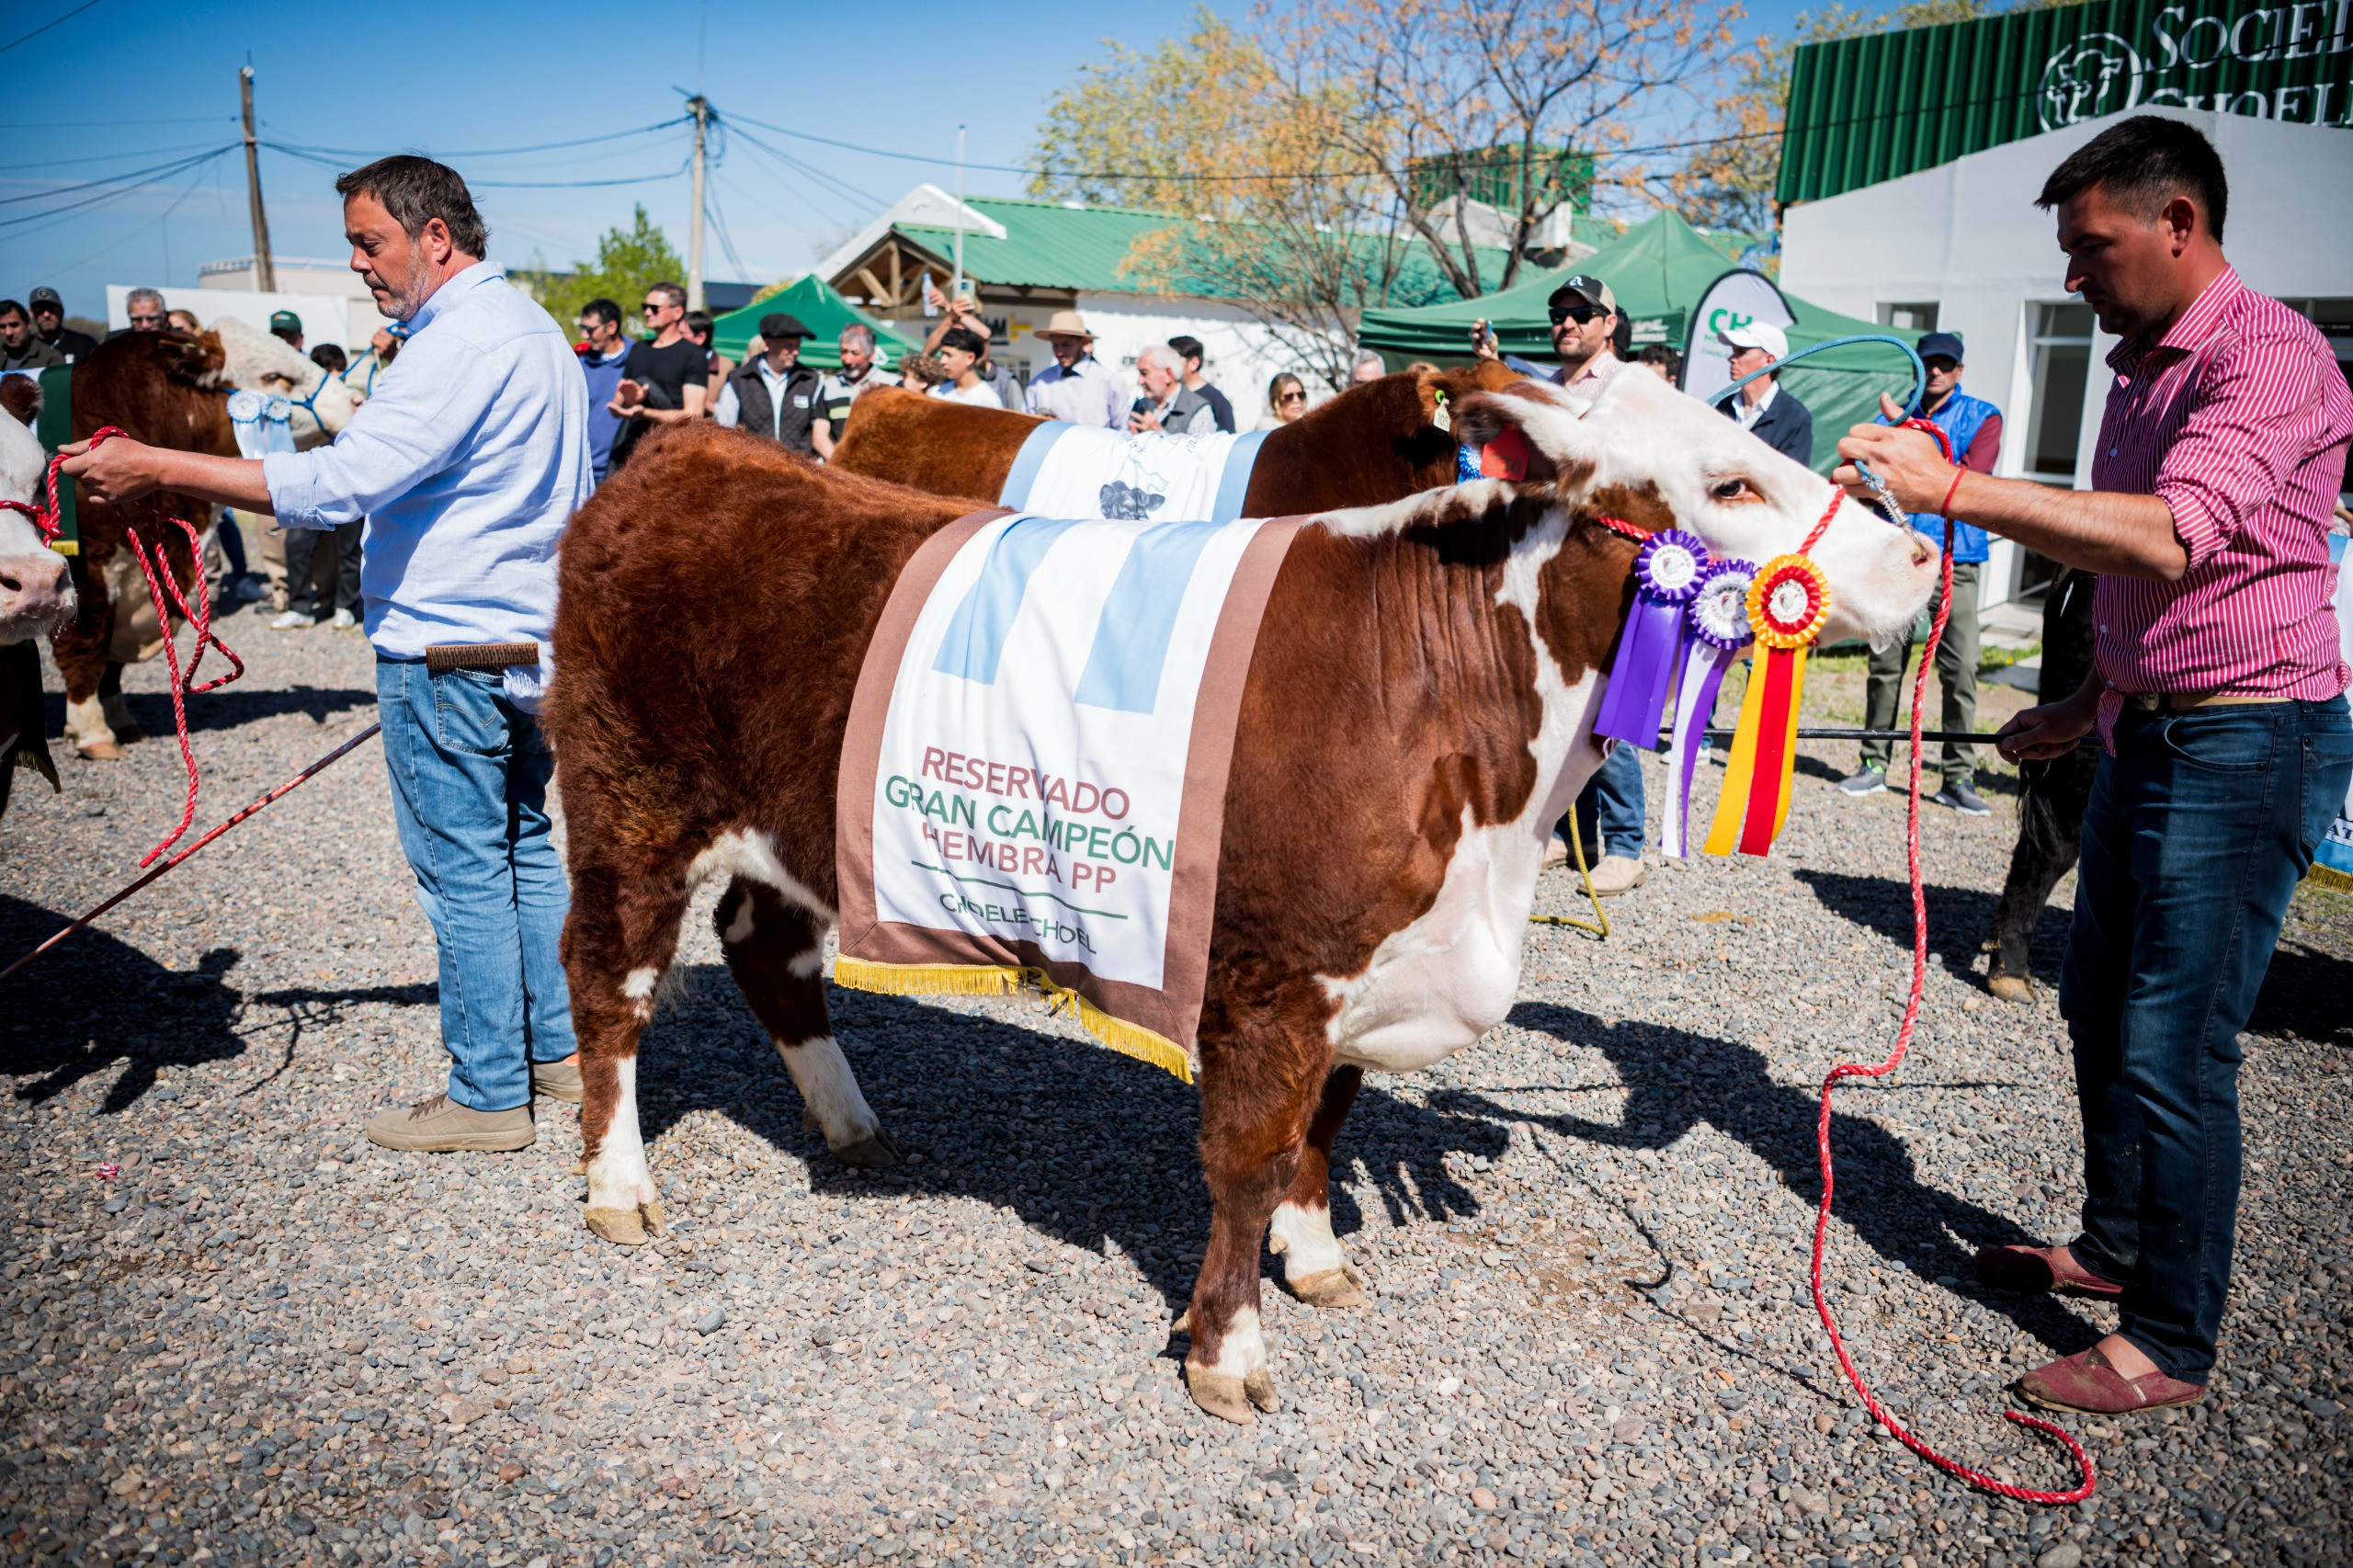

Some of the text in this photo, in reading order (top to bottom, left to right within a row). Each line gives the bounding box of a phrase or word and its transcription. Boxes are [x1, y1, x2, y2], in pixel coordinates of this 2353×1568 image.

[1438, 413, 1449, 428] 105
[1718, 586, 1748, 602] HEREFOR
[922, 746, 1130, 820] RESERVADO
[885, 775, 1174, 870] GRAN CAMPEÓN
[922, 823, 1116, 893] HEMBRA PP
